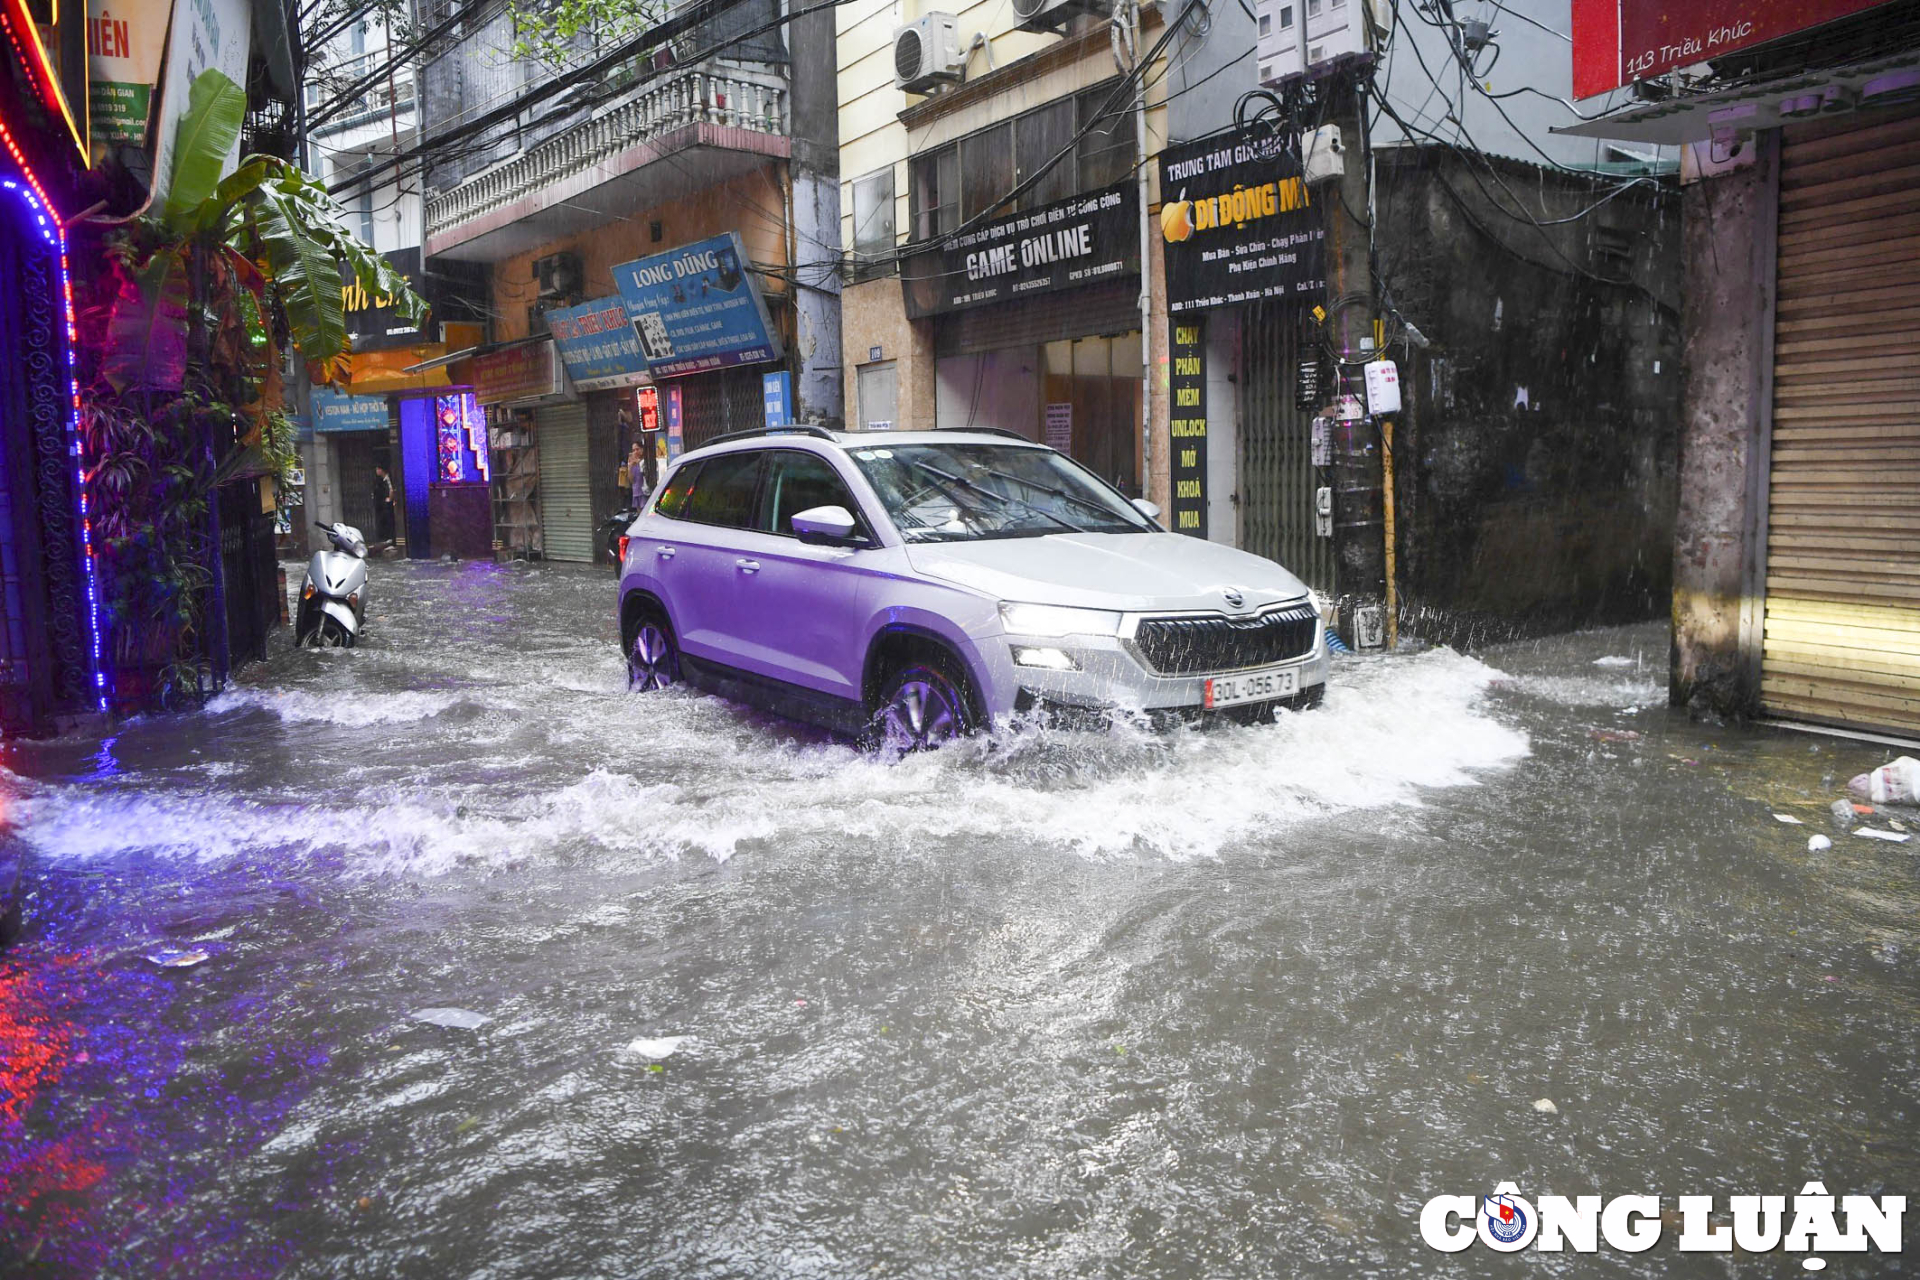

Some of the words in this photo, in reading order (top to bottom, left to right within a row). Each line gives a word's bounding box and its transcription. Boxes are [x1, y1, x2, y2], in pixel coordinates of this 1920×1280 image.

[1626, 50, 1655, 74] 113
[1660, 37, 1702, 63] Triều
[1707, 20, 1752, 48] Khúc
[117, 88, 135, 98] GIAN
[1168, 156, 1204, 182] TRUNG
[1206, 149, 1232, 170] TÂM
[959, 233, 976, 247] CUNG
[977, 227, 989, 244] CẤP
[990, 226, 1006, 242] DỊCH
[1006, 221, 1015, 237] VỤ
[1016, 217, 1030, 232] TRÒ
[1048, 208, 1065, 225] ĐIỆN
[1100, 193, 1121, 211] CỘNG
[1194, 197, 1218, 231] DI
[1219, 183, 1275, 230] ĐỘNG
[966, 243, 1017, 281] GAME
[1021, 223, 1092, 267] ONLINE
[1202, 251, 1217, 262] Mua
[1217, 247, 1230, 260] Bán
[1235, 243, 1248, 256] Sửa
[1249, 240, 1266, 253] Chữa
[1271, 235, 1289, 249] Chạy
[632, 264, 672, 289] LONG
[673, 249, 719, 279] DŨNG
[1229, 263, 1242, 274] Phụ
[1243, 259, 1258, 272] Kiện
[1259, 255, 1277, 268] Chính
[1185, 300, 1195, 310] 111
[1227, 292, 1245, 303] Thanh
[1246, 289, 1260, 300] Xuân
[1265, 287, 1273, 296] Hà
[1274, 285, 1285, 296] Nội
[577, 304, 603, 335] TRIỀU
[601, 301, 629, 331] KHÚC
[1176, 326, 1200, 348] CHẠY
[1175, 351, 1200, 375] PHẦN
[1177, 381, 1199, 407] MỀM
[1171, 419, 1206, 437] UNLOCK
[1181, 445, 1197, 468] MỞ
[1177, 477, 1201, 498] KHOÁ
[1179, 511, 1199, 529] MUA
[1214, 673, 1292, 701] 30L-056.73
